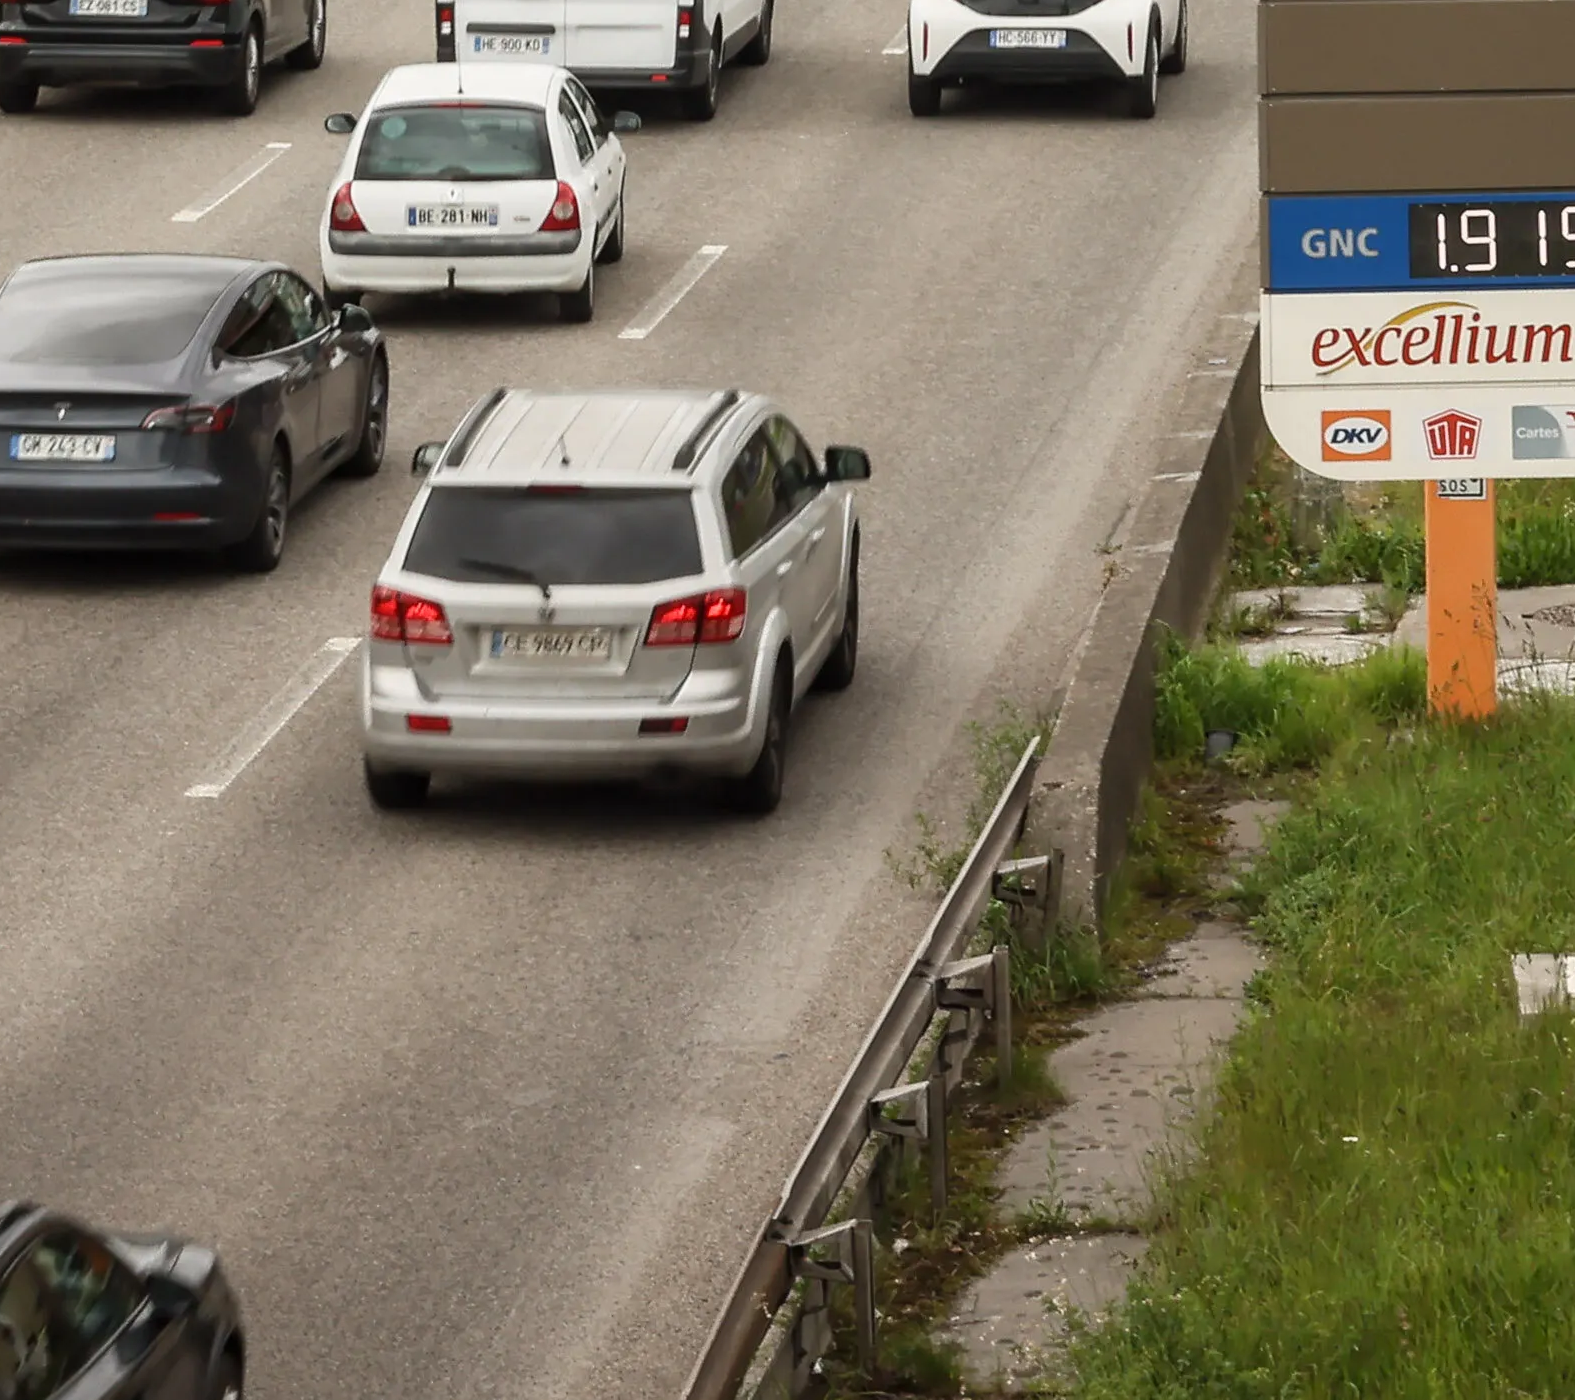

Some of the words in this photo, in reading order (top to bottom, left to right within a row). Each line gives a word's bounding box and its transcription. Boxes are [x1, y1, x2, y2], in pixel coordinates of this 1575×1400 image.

[1301, 227, 1379, 259] GNC
[1311, 311, 1574, 368] excellium
[1330, 426, 1383, 444] DKV
[1426, 413, 1479, 460] UTA
[1516, 427, 1560, 439] Cartes
[1438, 479, 1469, 493] SOS
